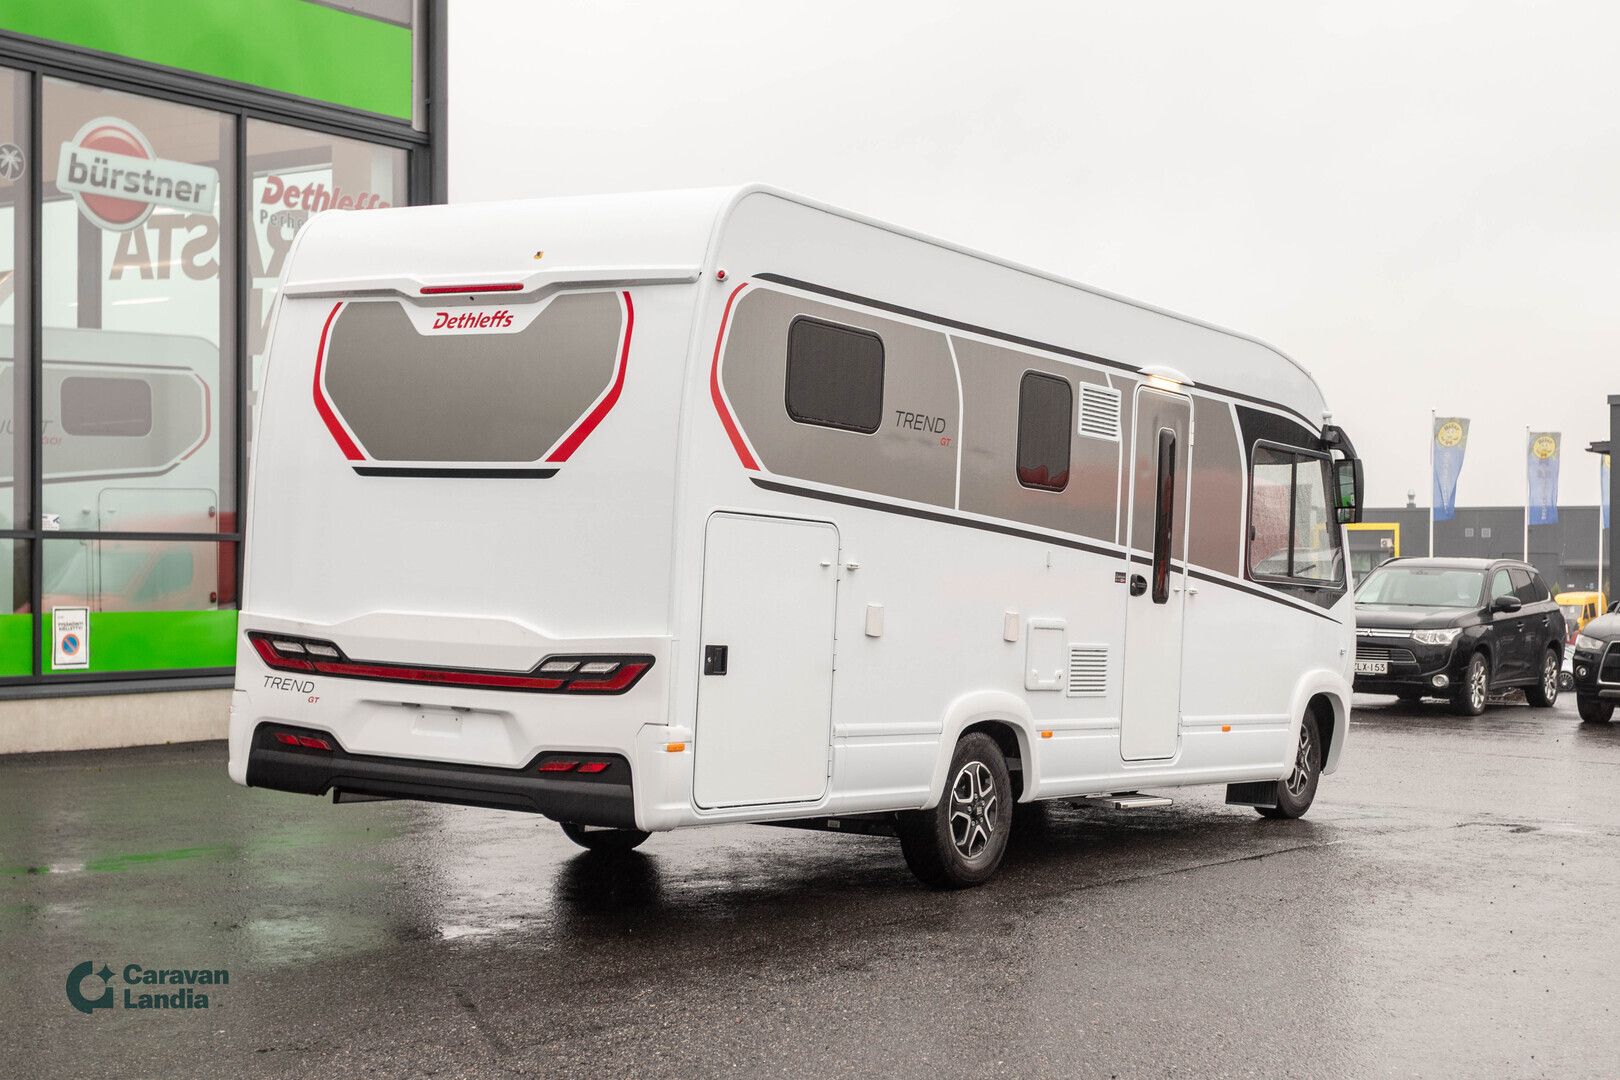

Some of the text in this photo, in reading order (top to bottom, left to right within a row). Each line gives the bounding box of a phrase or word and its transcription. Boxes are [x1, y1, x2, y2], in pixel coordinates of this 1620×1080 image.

[68, 152, 207, 204] bürstner
[432, 310, 514, 330] Dethleffs
[895, 410, 946, 434] TREND
[940, 437, 952, 447] GT
[263, 675, 315, 694] TREND
[307, 696, 320, 704] GT
